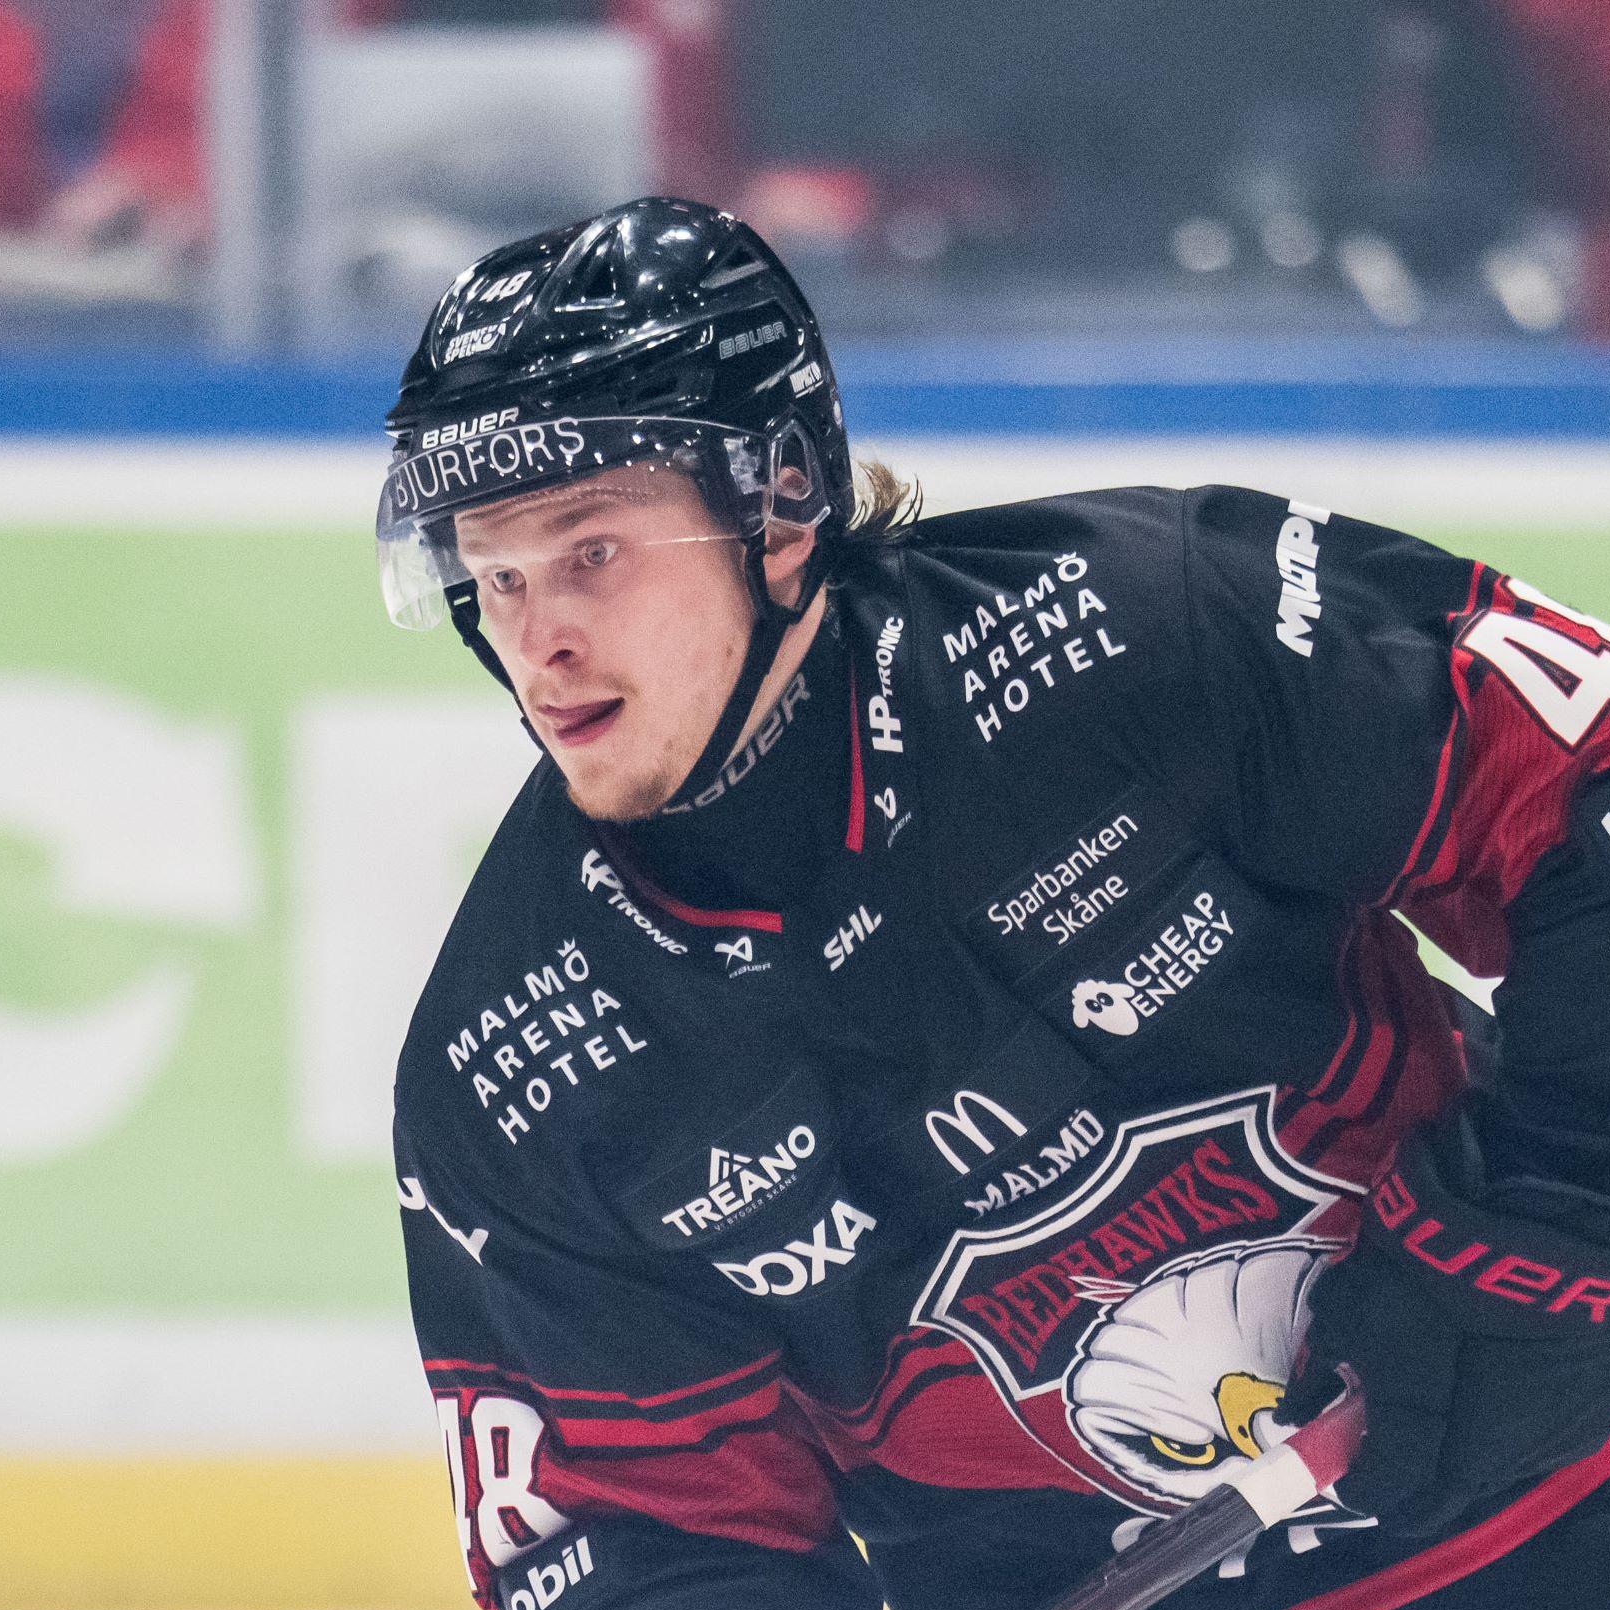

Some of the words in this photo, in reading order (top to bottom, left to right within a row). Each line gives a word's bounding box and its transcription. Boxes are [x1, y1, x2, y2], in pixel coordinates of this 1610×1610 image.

[479, 271, 533, 302] 48
[718, 321, 788, 360] BAUER
[393, 416, 586, 511] BJURFORS
[421, 406, 520, 450] BAUER
[963, 586, 1107, 704] ARENA
[974, 627, 1127, 743] HOTEL
[661, 672, 811, 814] AUER
[987, 813, 1139, 937] Sparbanken
[1042, 873, 1129, 946] Skåne
[823, 904, 883, 972] SHL
[1124, 891, 1215, 989] CHEAP
[1129, 908, 1235, 1020] ENERGY
[472, 988, 622, 1108] ARENA
[497, 1024, 649, 1146] HOTEL
[963, 1107, 1106, 1219] MALMÖ
[959, 1137, 1280, 1374] REDHAWKS
